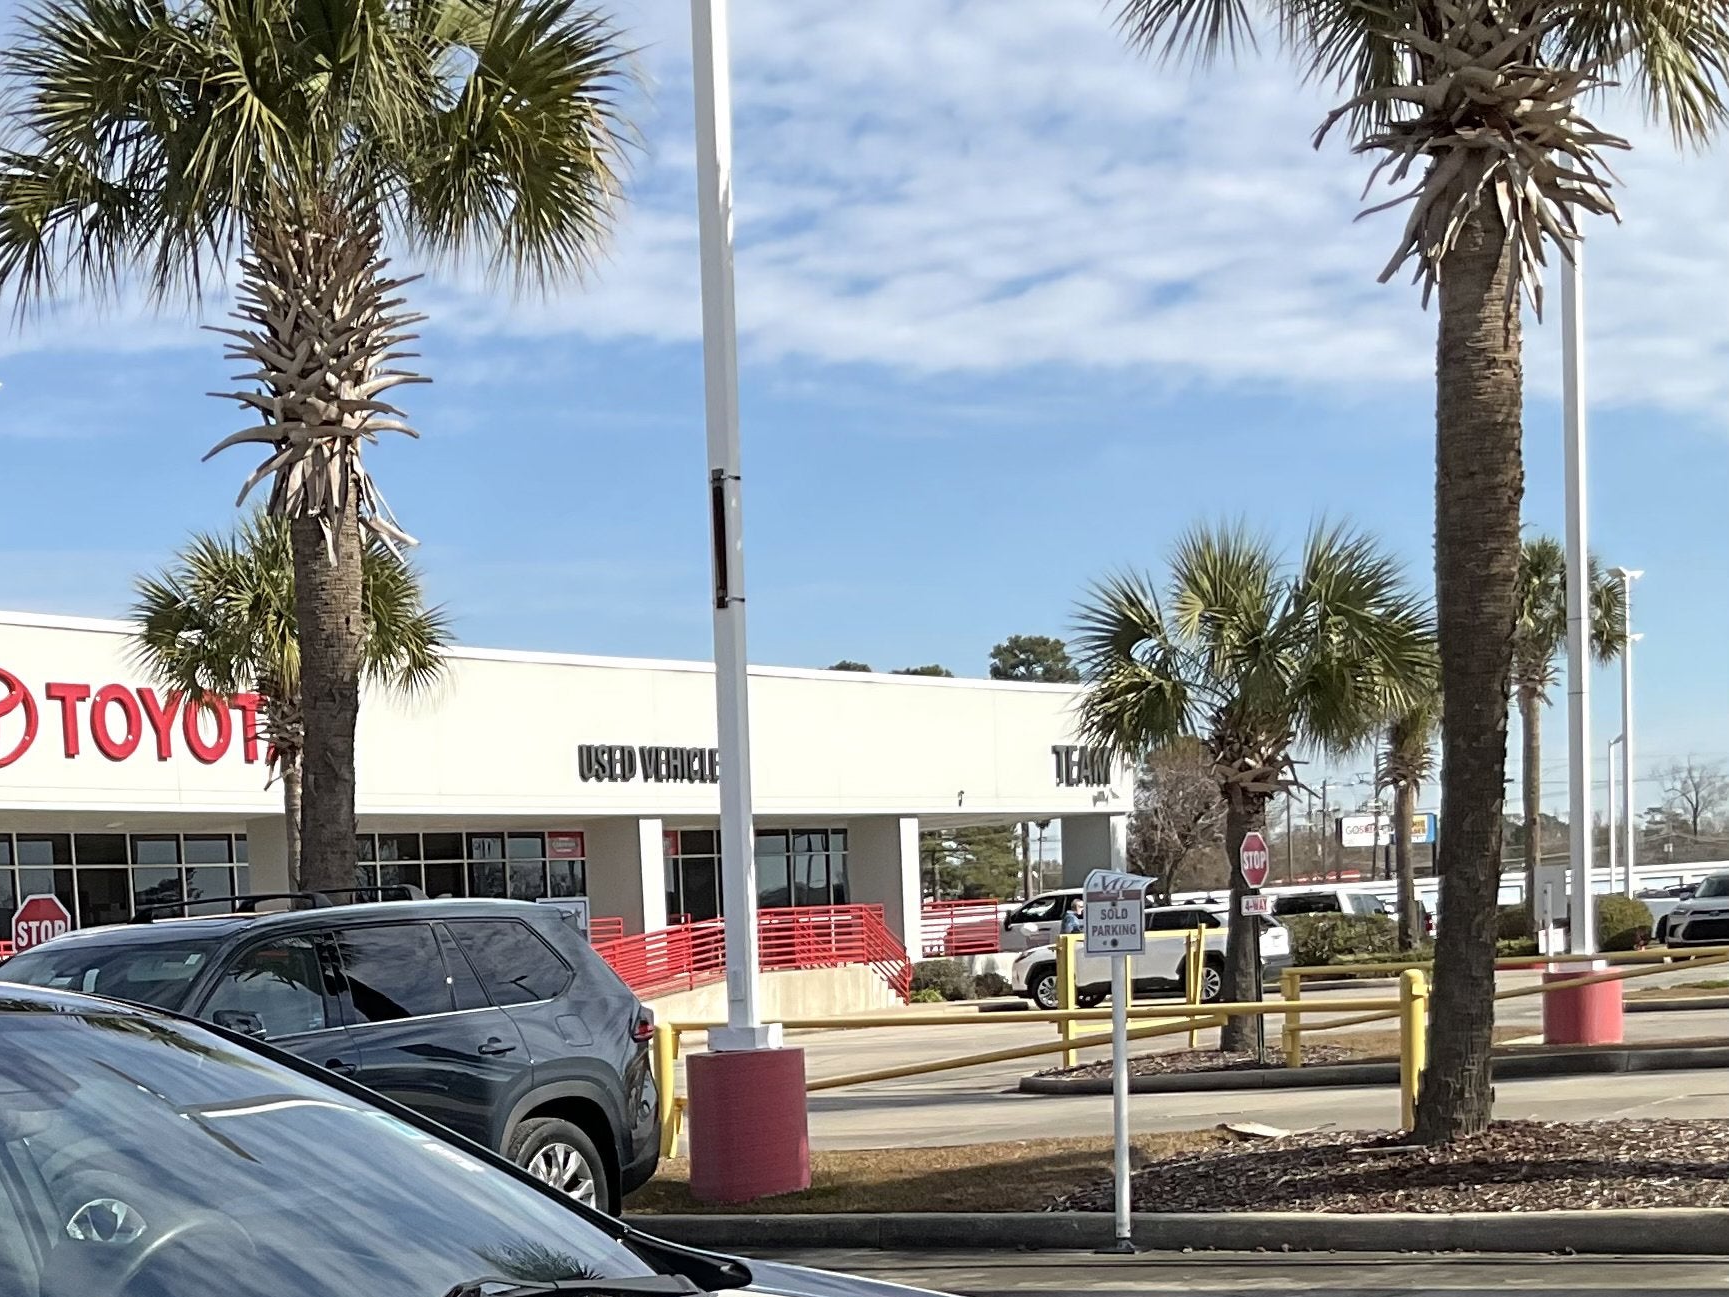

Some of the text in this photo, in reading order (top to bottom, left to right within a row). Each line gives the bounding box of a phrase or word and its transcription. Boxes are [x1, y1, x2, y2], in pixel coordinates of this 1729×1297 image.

[45, 682, 278, 766] TOYOT
[578, 744, 720, 784] USED VEHICLE
[1243, 850, 1266, 870] STOP
[1100, 908, 1128, 920] SOLD
[17, 919, 66, 947] STOP
[1092, 924, 1137, 937] PARKING
